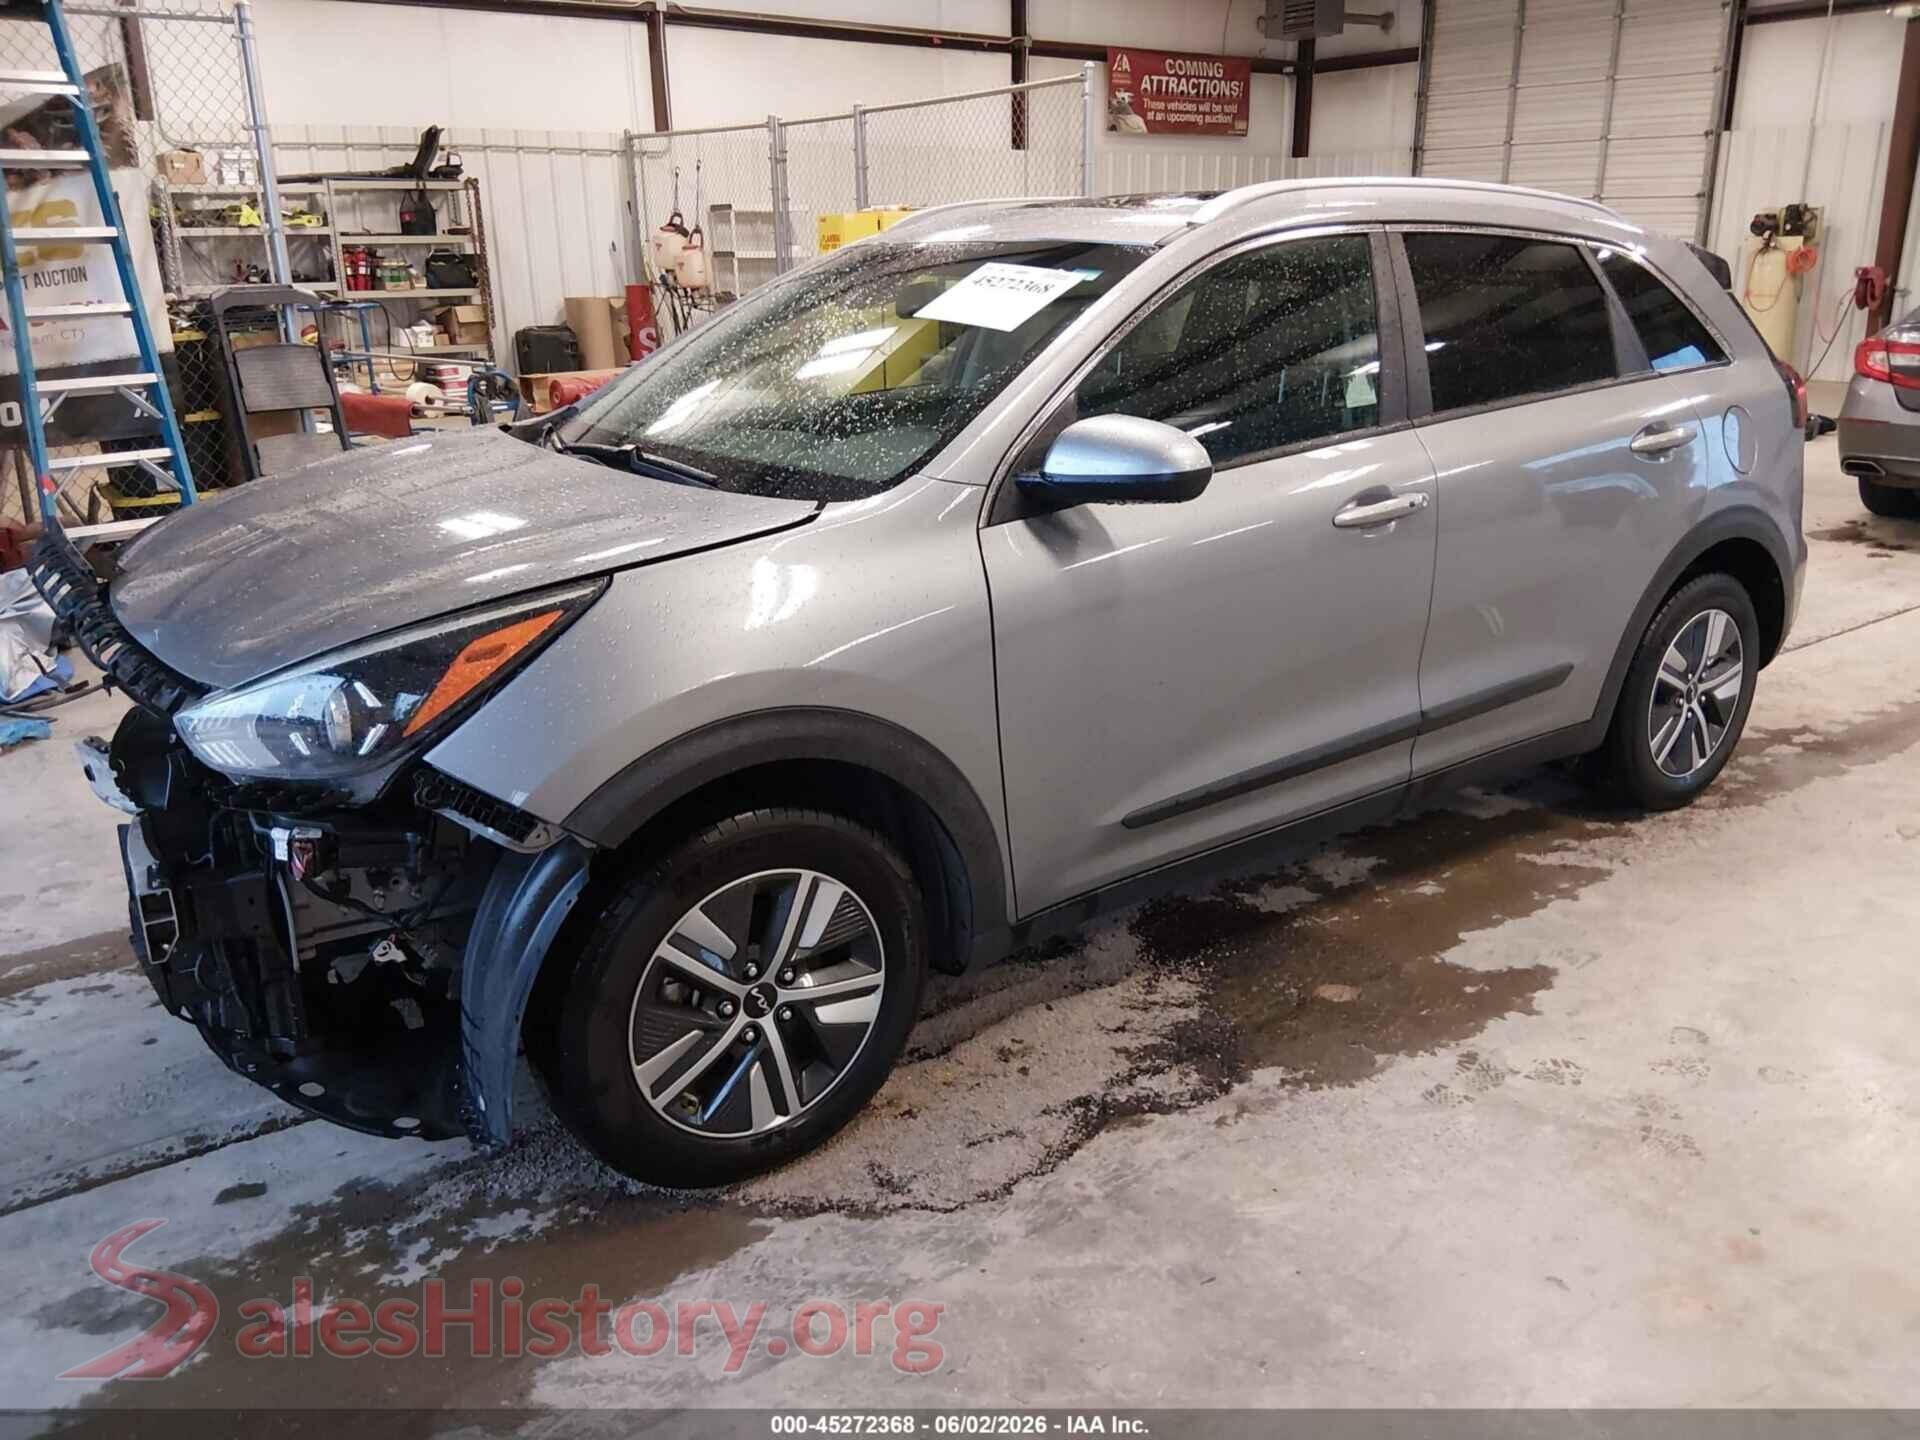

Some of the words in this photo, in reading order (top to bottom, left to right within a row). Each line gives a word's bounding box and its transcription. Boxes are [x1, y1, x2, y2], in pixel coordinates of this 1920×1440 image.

[1164, 58, 1224, 78] COMING
[1140, 75, 1244, 97] ATTRACTIONS!
[1144, 98, 1166, 111] These
[1167, 100, 1198, 112] vehicles
[1198, 103, 1211, 112] will
[1212, 103, 1222, 113] be
[1223, 103, 1238, 113] sold
[1147, 111, 1155, 120] at
[1155, 112, 1166, 121] an
[1166, 113, 1204, 126] upcoming
[33, 265, 88, 289] AUCTION
